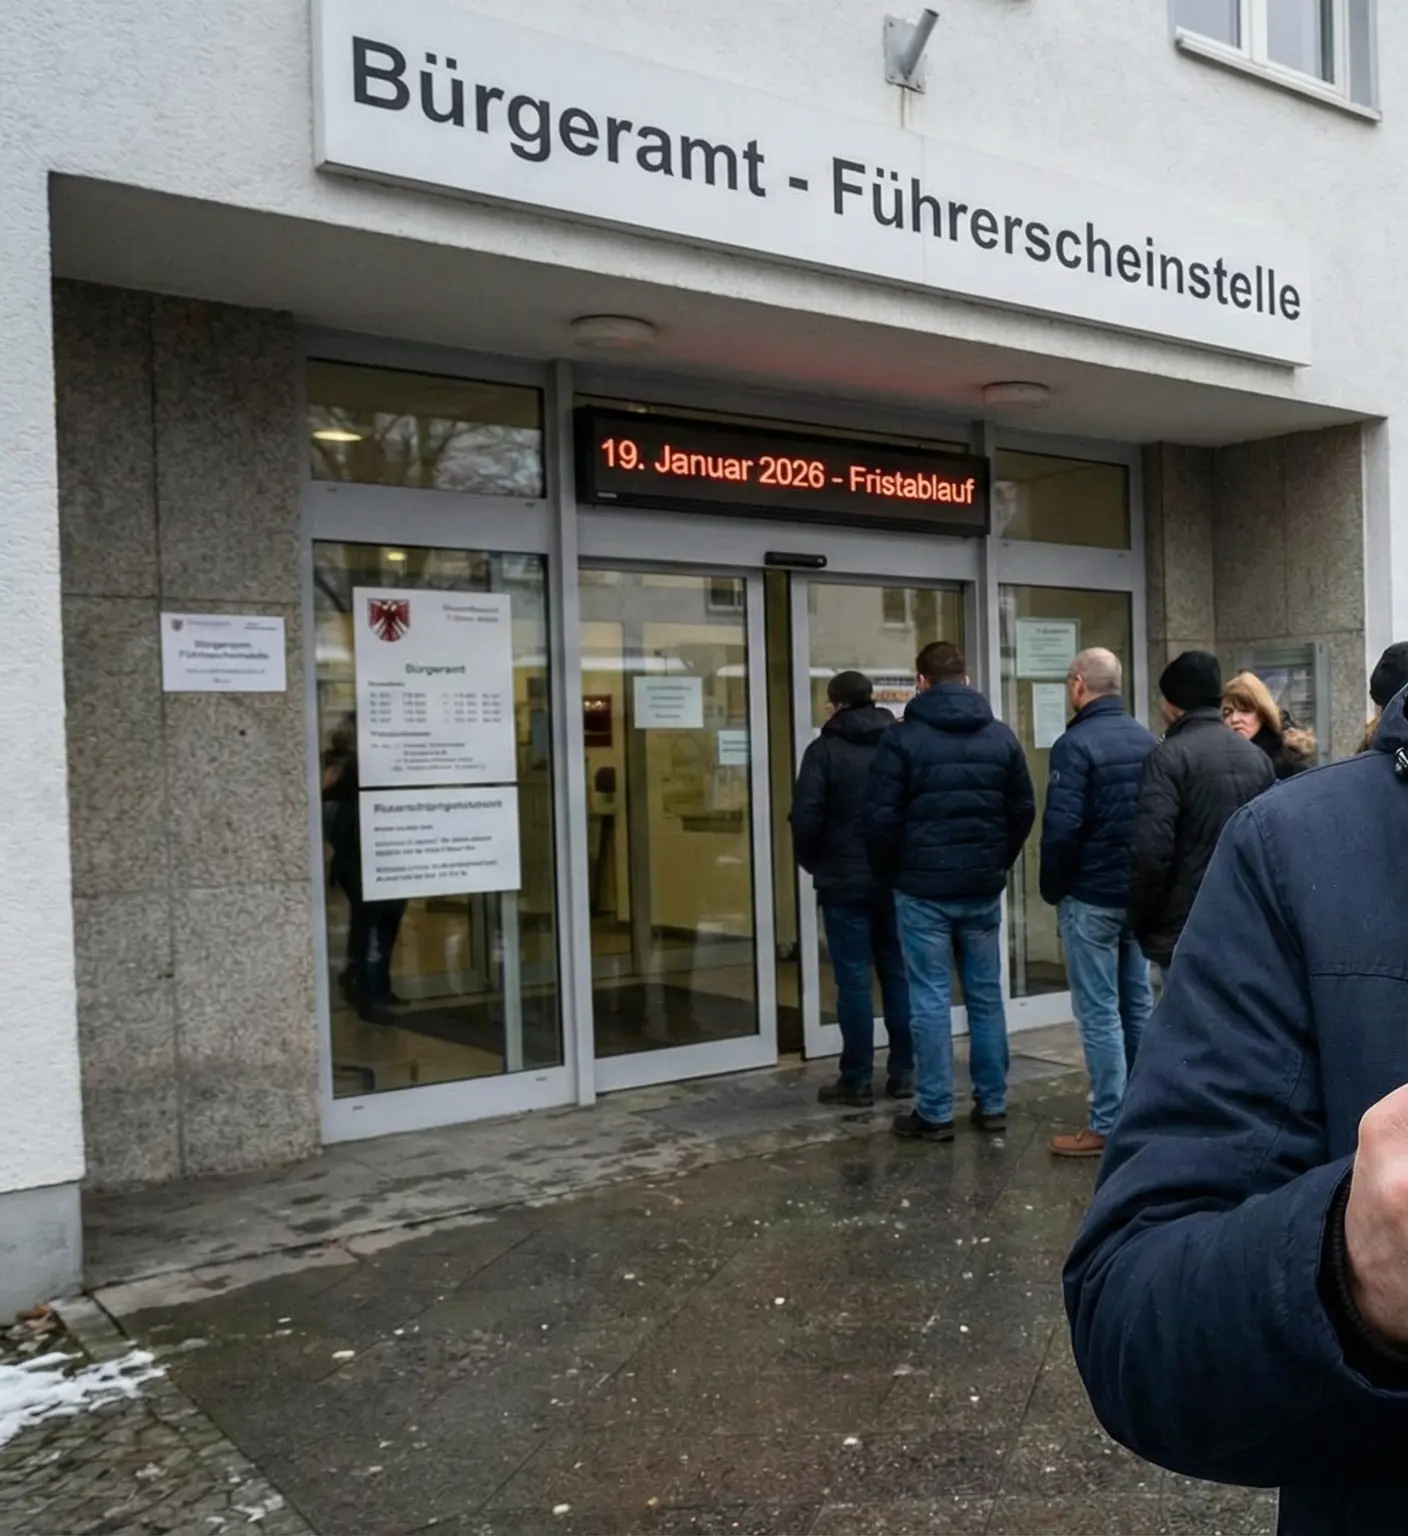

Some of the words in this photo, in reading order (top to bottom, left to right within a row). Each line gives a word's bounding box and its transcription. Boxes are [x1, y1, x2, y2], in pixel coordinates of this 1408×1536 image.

[352, 35, 766, 197] Bürgeramt
[788, 176, 809, 191] -
[832, 156, 1301, 320] Führerscheinstelle
[601, 438, 645, 470] 19.
[654, 444, 753, 482] Januar
[759, 456, 825, 489] 2026
[849, 465, 975, 504] Fristablauf
